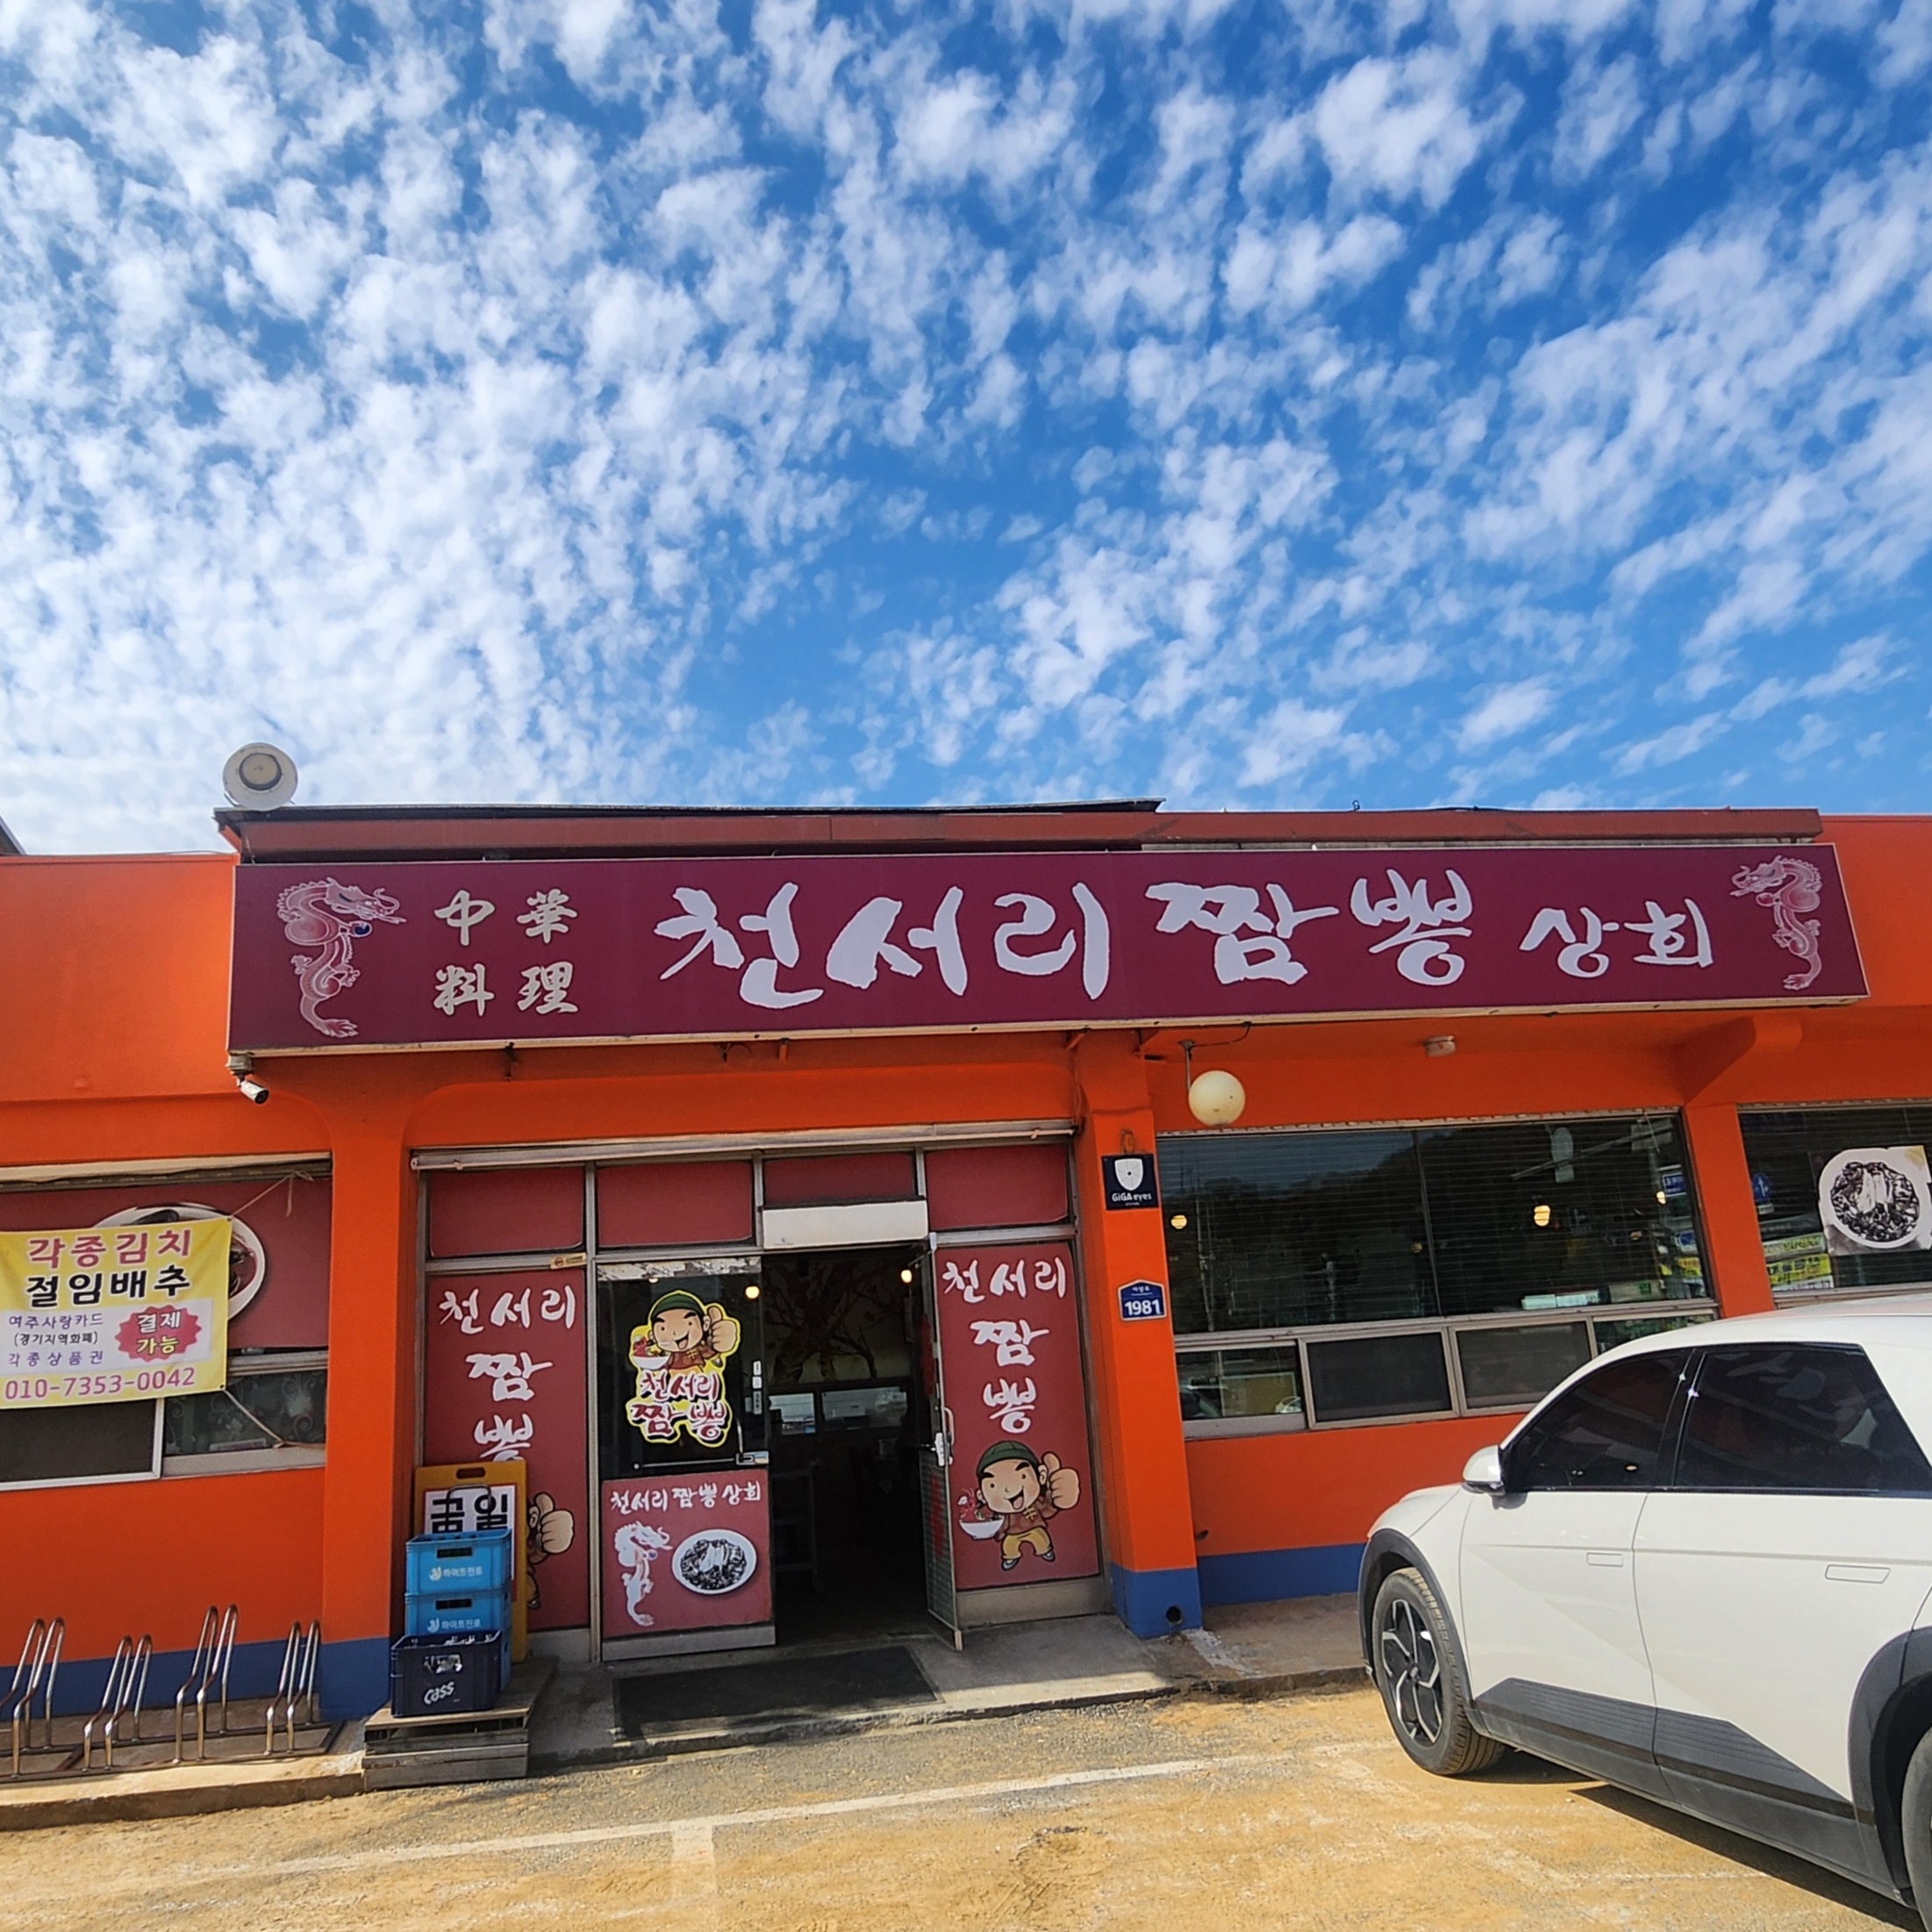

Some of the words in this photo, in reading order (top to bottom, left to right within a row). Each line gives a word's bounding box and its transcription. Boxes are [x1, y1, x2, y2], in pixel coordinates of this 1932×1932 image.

[434, 889, 576, 945] 中華
[654, 882, 1109, 1009] 천서리
[1145, 869, 1472, 984] 짬뽕
[1521, 898, 1713, 977] 상회
[433, 962, 577, 1016] 料理
[29, 1229, 191, 1269] 각종김치
[26, 1264, 190, 1308] 절임배추
[941, 1257, 1066, 1303] 천서리
[9, 1313, 104, 1330] 여주사랑카드
[137, 1311, 182, 1334] 결제
[439, 1284, 576, 1335] 천서리
[1124, 1299, 1162, 1316] 1981
[13, 1331, 98, 1347] (경기지역화폐)
[137, 1335, 179, 1356] 가능
[8, 1350, 104, 1367] 각종상품권
[5, 1367, 195, 1399] 010-7353-0042
[641, 1369, 719, 1400] 천서리
[632, 1402, 726, 1440] 짬뽕
[610, 1488, 668, 1514] 천서리
[671, 1482, 718, 1508] 짬뽕
[721, 1479, 762, 1506] 상회
